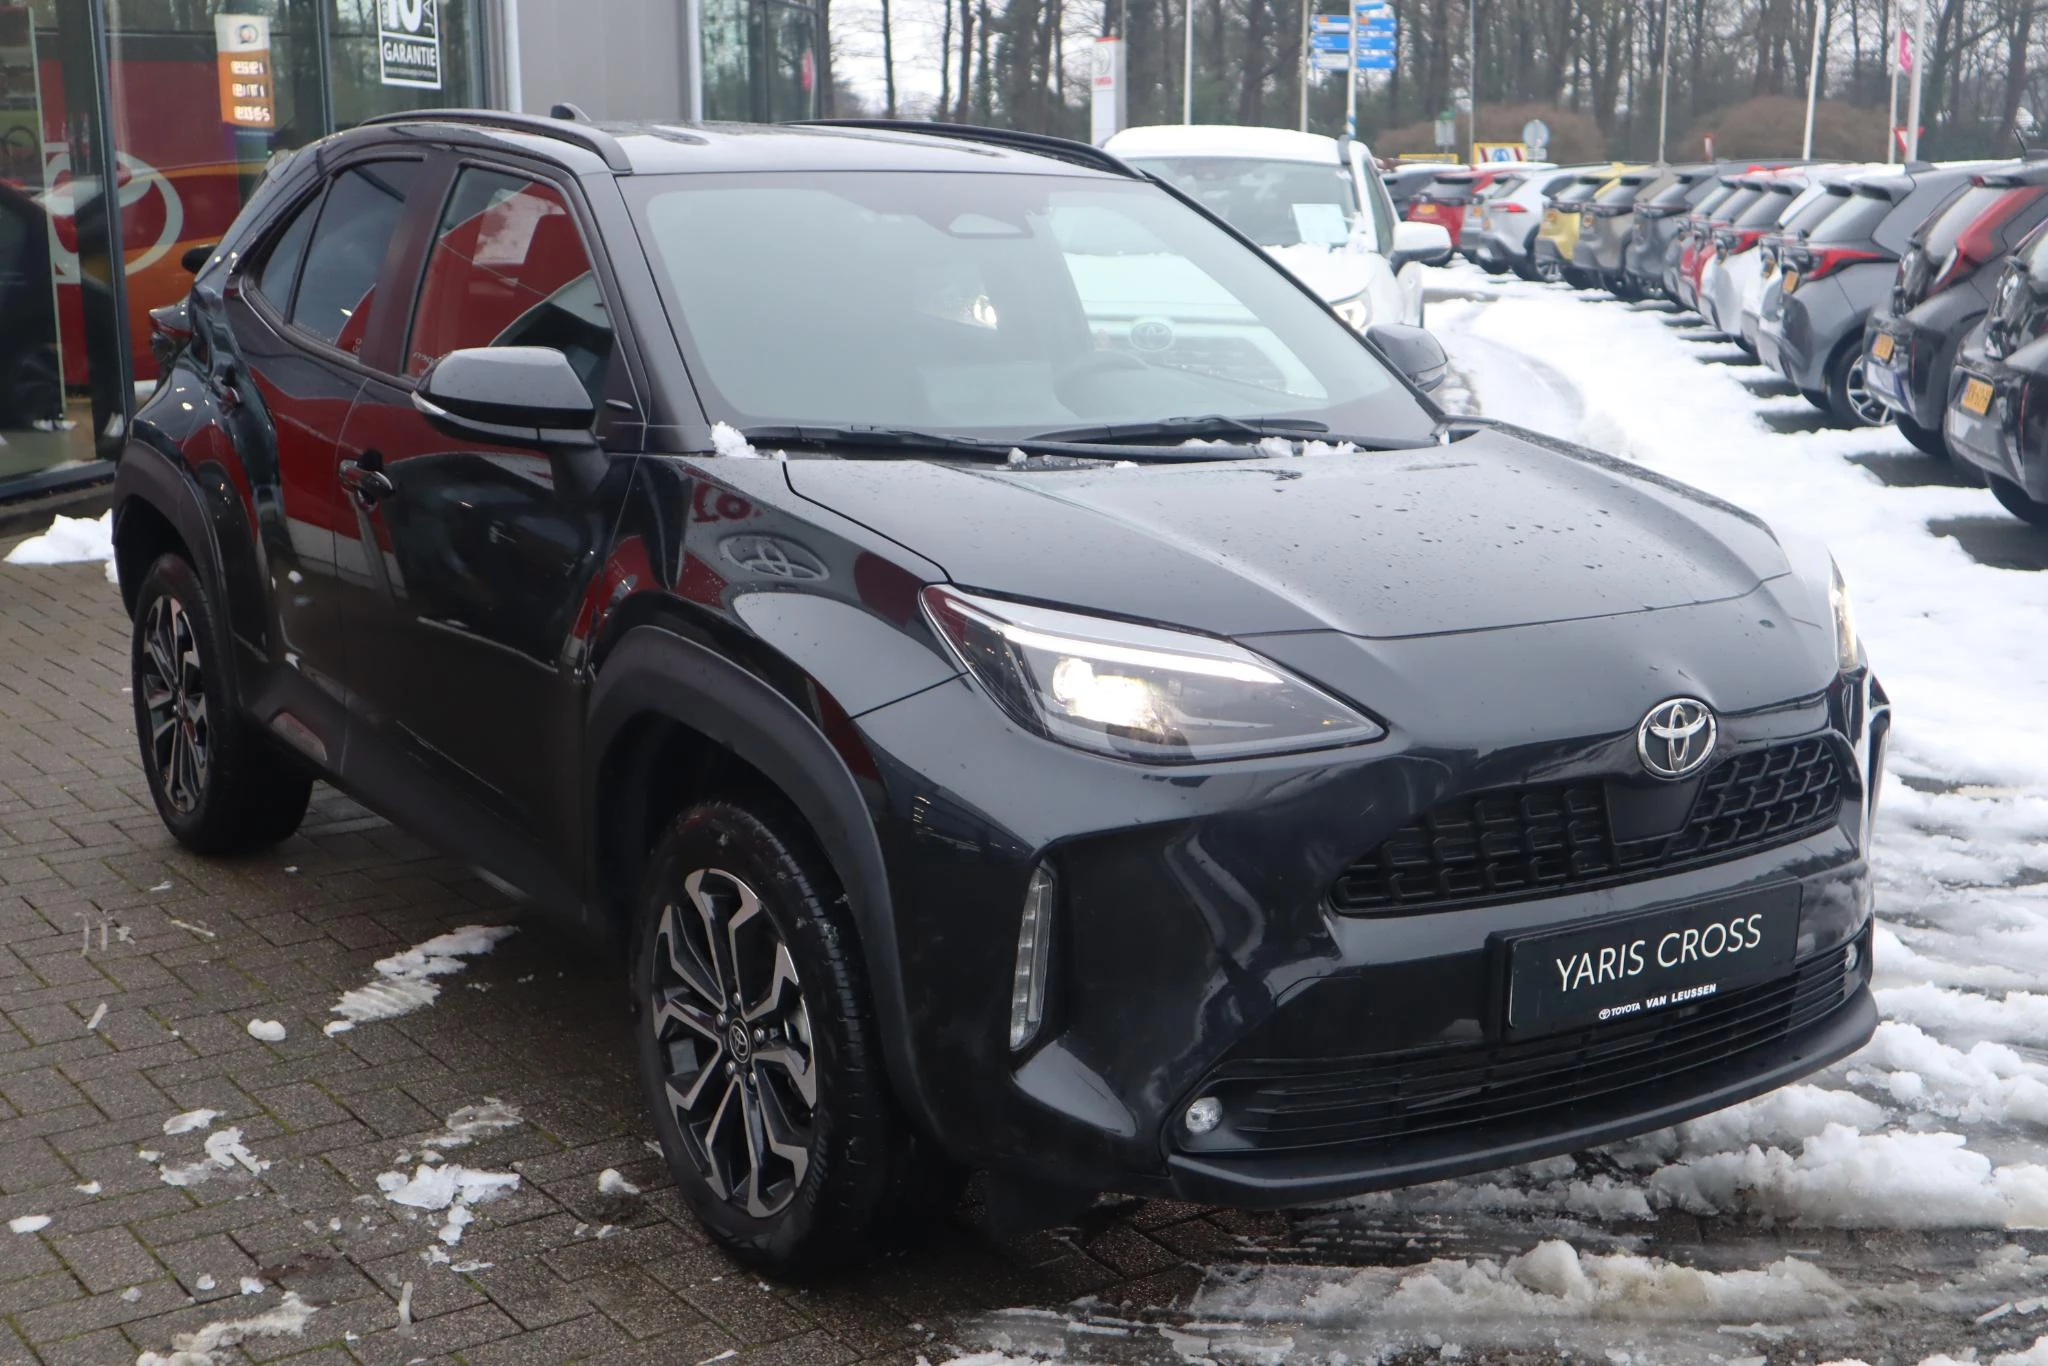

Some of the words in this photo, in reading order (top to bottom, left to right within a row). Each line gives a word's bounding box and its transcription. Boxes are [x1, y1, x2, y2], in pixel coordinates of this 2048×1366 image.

[383, 41, 437, 68] GARANTIE
[1556, 940, 1646, 992] YARIS
[1657, 913, 1763, 968] CROSS
[1611, 1002, 1641, 1016] TOYOTA
[1646, 995, 1667, 1009] VAN
[1671, 983, 1717, 1003] LEUSSEN
